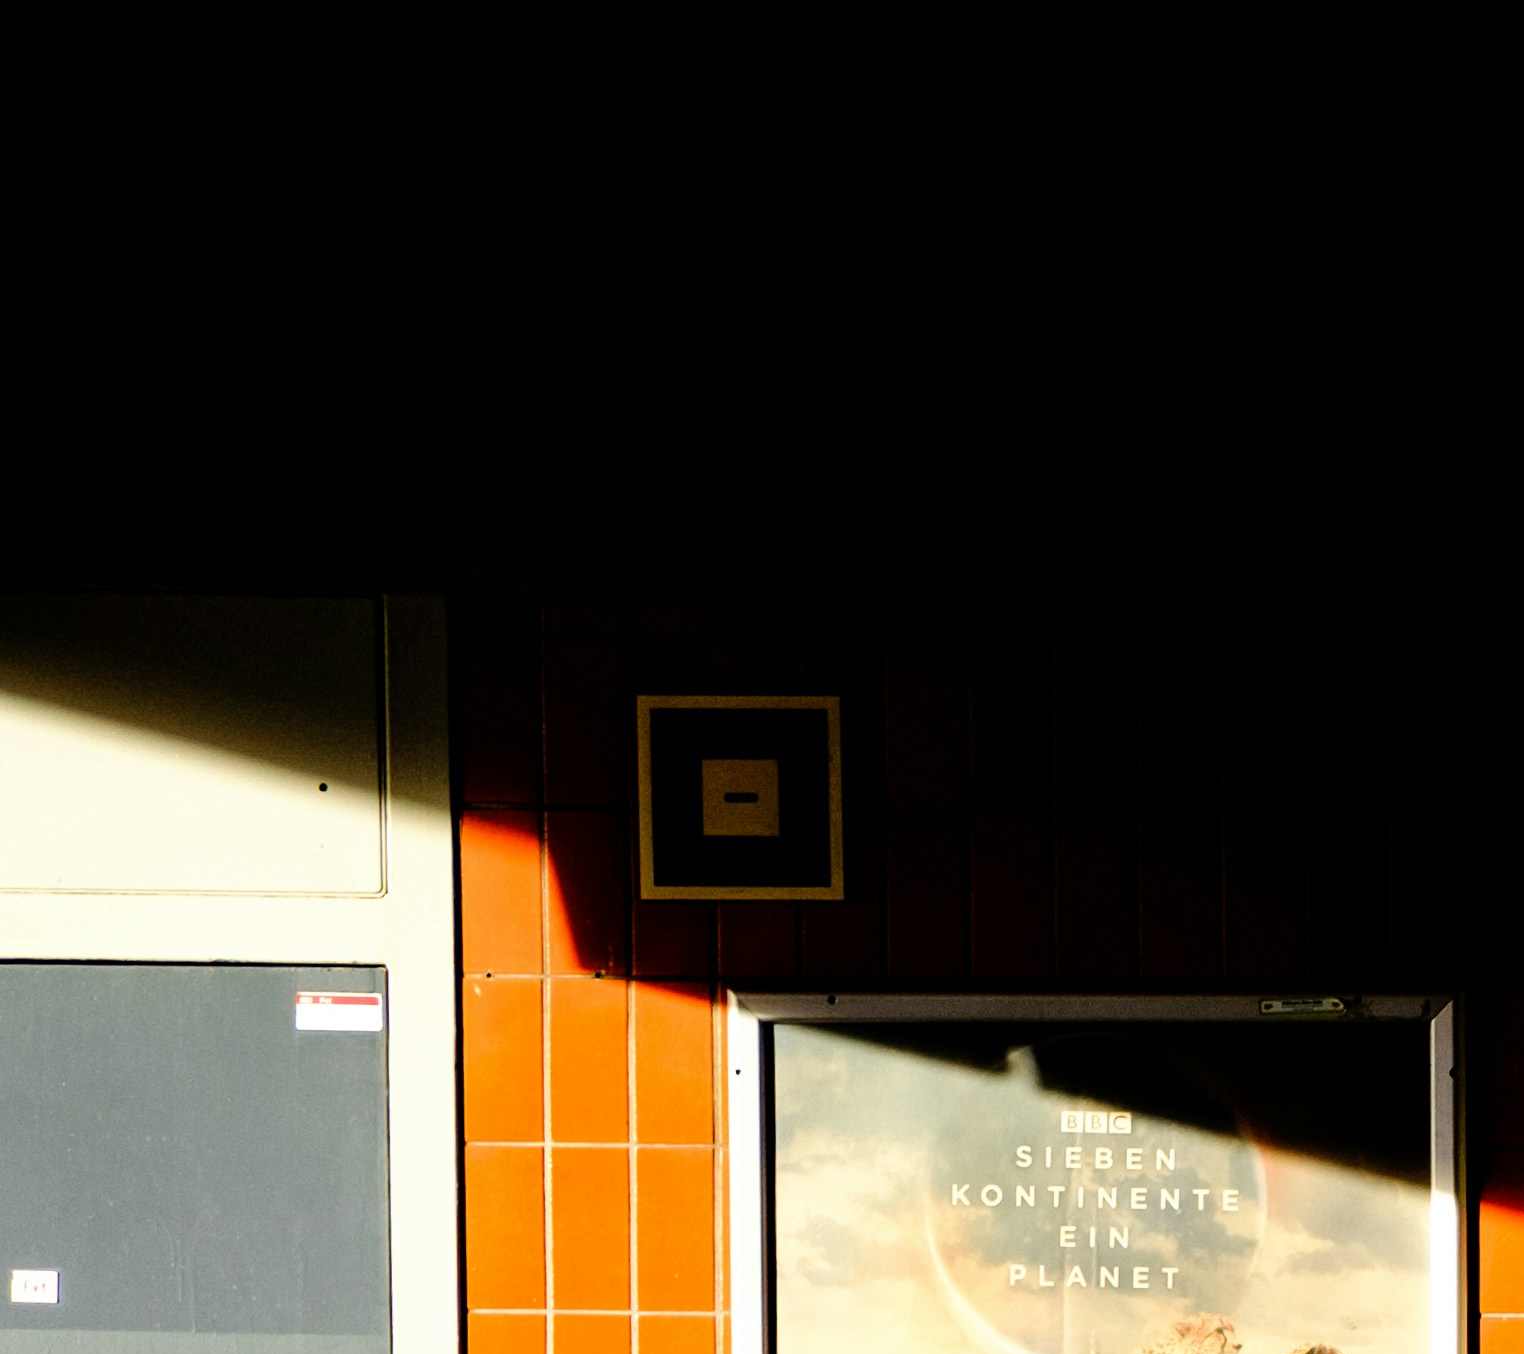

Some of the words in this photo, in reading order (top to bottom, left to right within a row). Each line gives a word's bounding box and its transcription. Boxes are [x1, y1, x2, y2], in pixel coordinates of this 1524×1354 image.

[1063, 1112, 1131, 1133] BBC
[1016, 1145, 1175, 1171] SIEBEN
[951, 1184, 1240, 1211] KONTINENTE
[1059, 1226, 1130, 1249] EIN
[1009, 1264, 1180, 1289] PLANET
